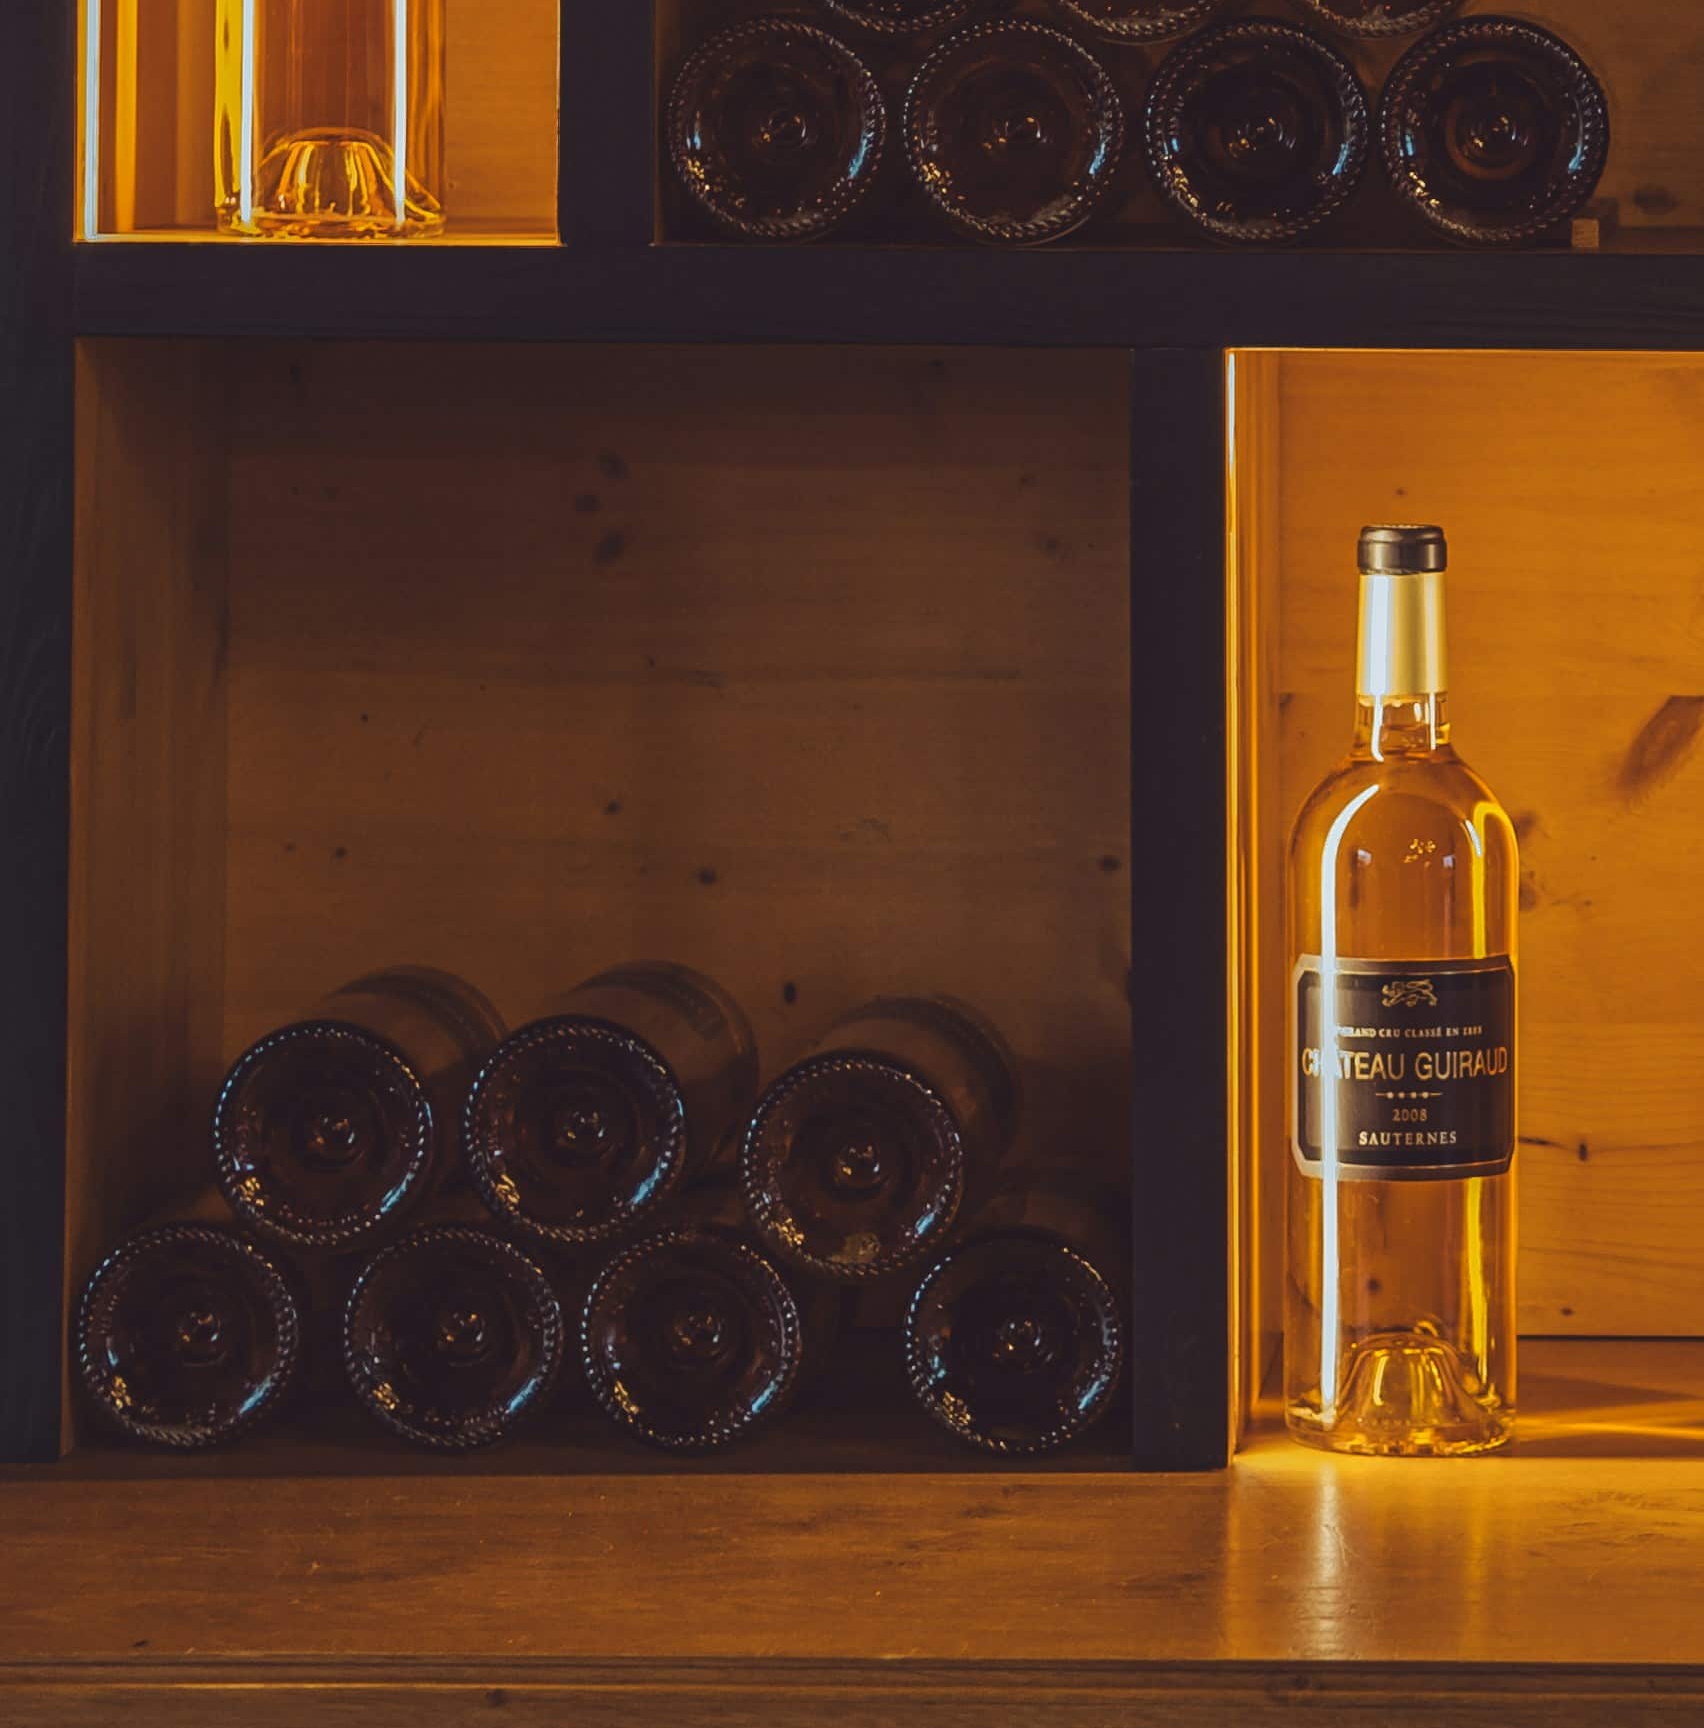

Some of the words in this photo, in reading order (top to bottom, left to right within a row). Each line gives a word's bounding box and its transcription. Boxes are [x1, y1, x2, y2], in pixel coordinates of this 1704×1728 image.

[1378, 1025, 1401, 1038] CRU
[1404, 1024, 1443, 1038] CLASSÉ
[1446, 1026, 1459, 1037] EN
[1415, 1046, 1508, 1081] GUIRAUD
[1392, 1108, 1428, 1122] 2008
[1358, 1130, 1457, 1147] SAUTERNES
